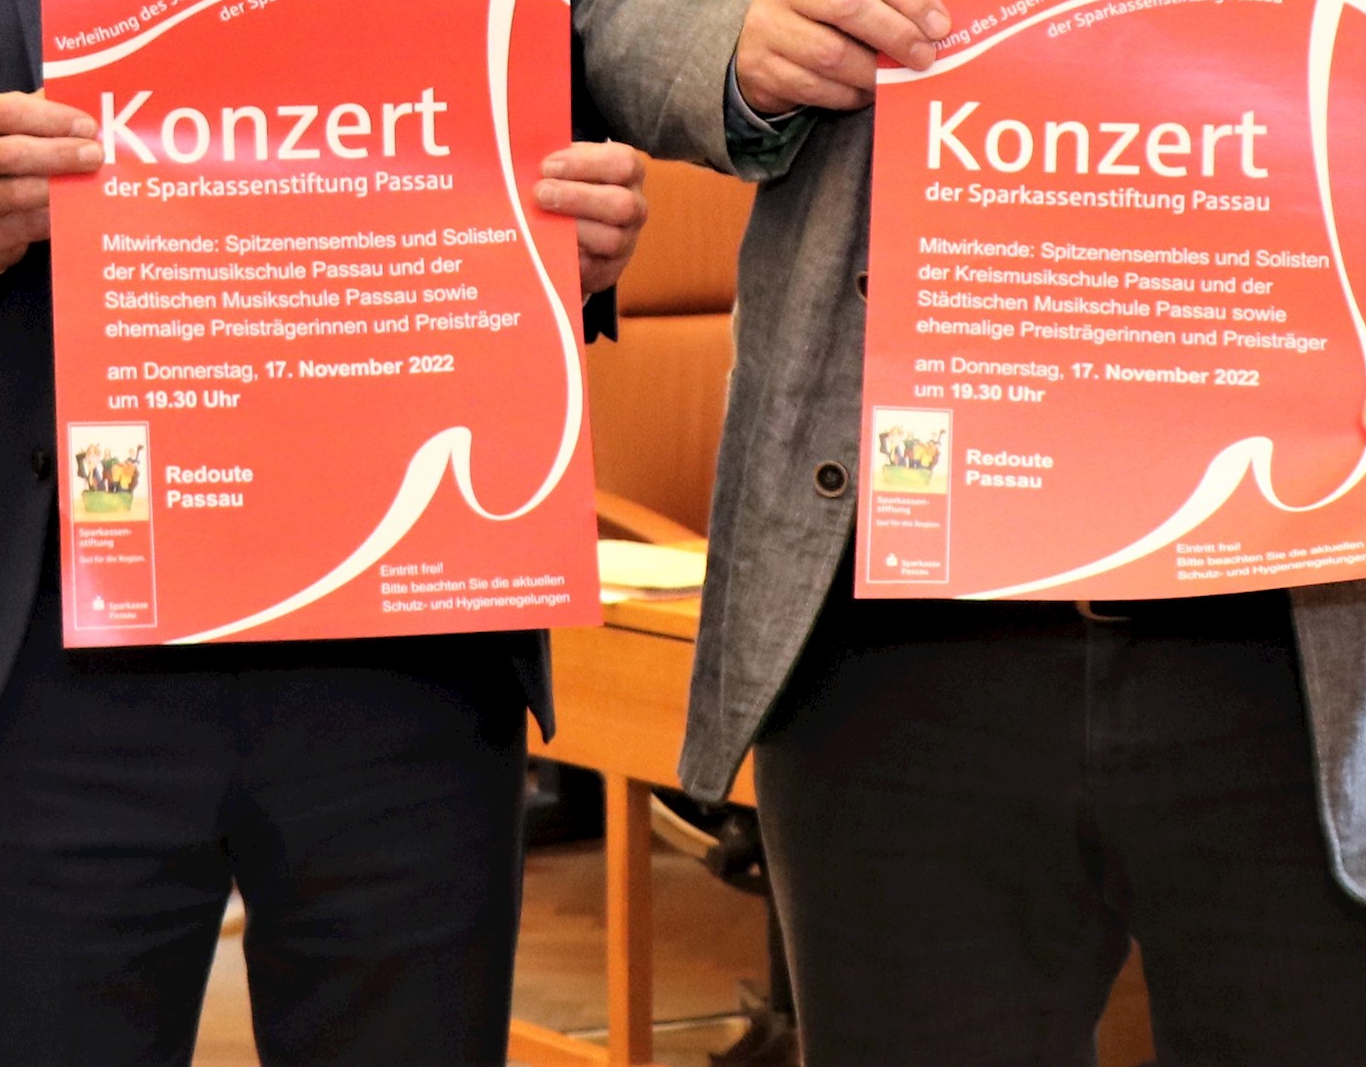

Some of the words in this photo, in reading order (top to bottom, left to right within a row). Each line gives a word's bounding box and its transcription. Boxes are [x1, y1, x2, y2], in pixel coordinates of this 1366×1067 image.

[54, 16, 140, 51] Verleihung
[139, 0, 168, 21] des
[219, 2, 245, 21] der
[101, 87, 450, 165] Konzert
[927, 100, 1269, 178] Konzert
[104, 176, 142, 197] der
[146, 172, 368, 202] Sparkassenstiftung
[374, 171, 453, 191] Passau
[925, 181, 964, 202] der
[968, 183, 1185, 215] Sparkassenstiftung
[1192, 190, 1270, 211] Passau
[102, 234, 219, 253] Mitwirkende:
[225, 231, 397, 255] Spitzenensembles
[401, 229, 437, 248] und
[443, 223, 516, 245] Solisten
[919, 237, 1035, 258] Mitwirkende:
[1041, 242, 1210, 265] Spitzenensembles
[1215, 250, 1250, 267] und
[1256, 248, 1330, 268] Solisten
[103, 262, 135, 280] der
[140, 262, 307, 281] Kreismusikschule
[312, 261, 383, 278] Passau
[389, 257, 425, 277] und
[430, 256, 462, 273] der
[918, 264, 951, 280] der
[954, 265, 1119, 288] Kreismusikschule
[1124, 272, 1195, 292] Passau
[1200, 277, 1236, 293] und
[1241, 278, 1274, 295] der
[105, 291, 217, 309] Städtischen
[222, 289, 340, 309] Musikschule
[346, 288, 417, 306] Passau
[423, 283, 478, 303] sowie
[917, 290, 1028, 311] Städtischen
[1033, 295, 1150, 317] Musikschule
[1155, 300, 1226, 320] Passau
[1232, 305, 1287, 322] sowie
[105, 320, 205, 341] ehemalige
[211, 318, 367, 338] Preisträgerinnen
[373, 314, 409, 334] und
[415, 311, 521, 331] Preisträger
[107, 366, 137, 380] am
[143, 361, 258, 383] Donnerstag,
[265, 360, 293, 378] 17.
[299, 358, 404, 378] November
[409, 354, 455, 373] 2022
[915, 359, 945, 372] am
[951, 357, 1064, 381] Donnerstag,
[1072, 362, 1099, 379] 17.
[1105, 363, 1210, 384] November
[1214, 368, 1259, 386] 2022
[108, 395, 139, 409] um
[145, 390, 197, 409] 19.30
[203, 390, 241, 408] Uhr
[914, 385, 944, 398] um
[951, 383, 1002, 400] 19.30
[1008, 385, 1046, 403] Uhr
[966, 449, 1054, 469] Redoute
[165, 465, 253, 484] Redoute
[965, 470, 1042, 489] Passau
[166, 490, 243, 508] Passau
